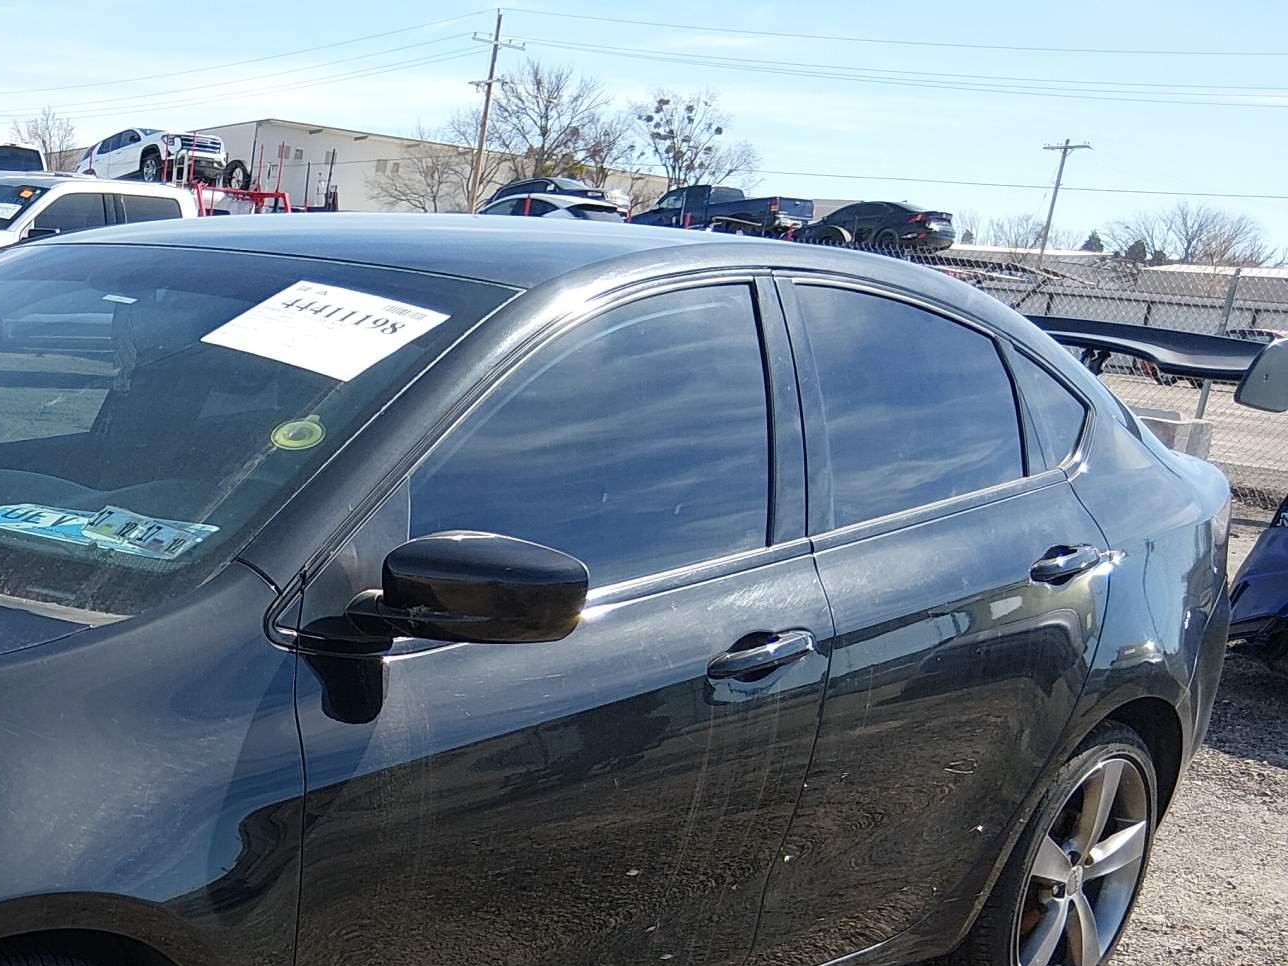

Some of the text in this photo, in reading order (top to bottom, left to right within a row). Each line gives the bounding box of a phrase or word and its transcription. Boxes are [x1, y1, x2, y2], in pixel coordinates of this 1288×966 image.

[280, 297, 406, 335] 44411198
[88, 509, 138, 537] 17 12
[136, 523, 163, 543] 17
